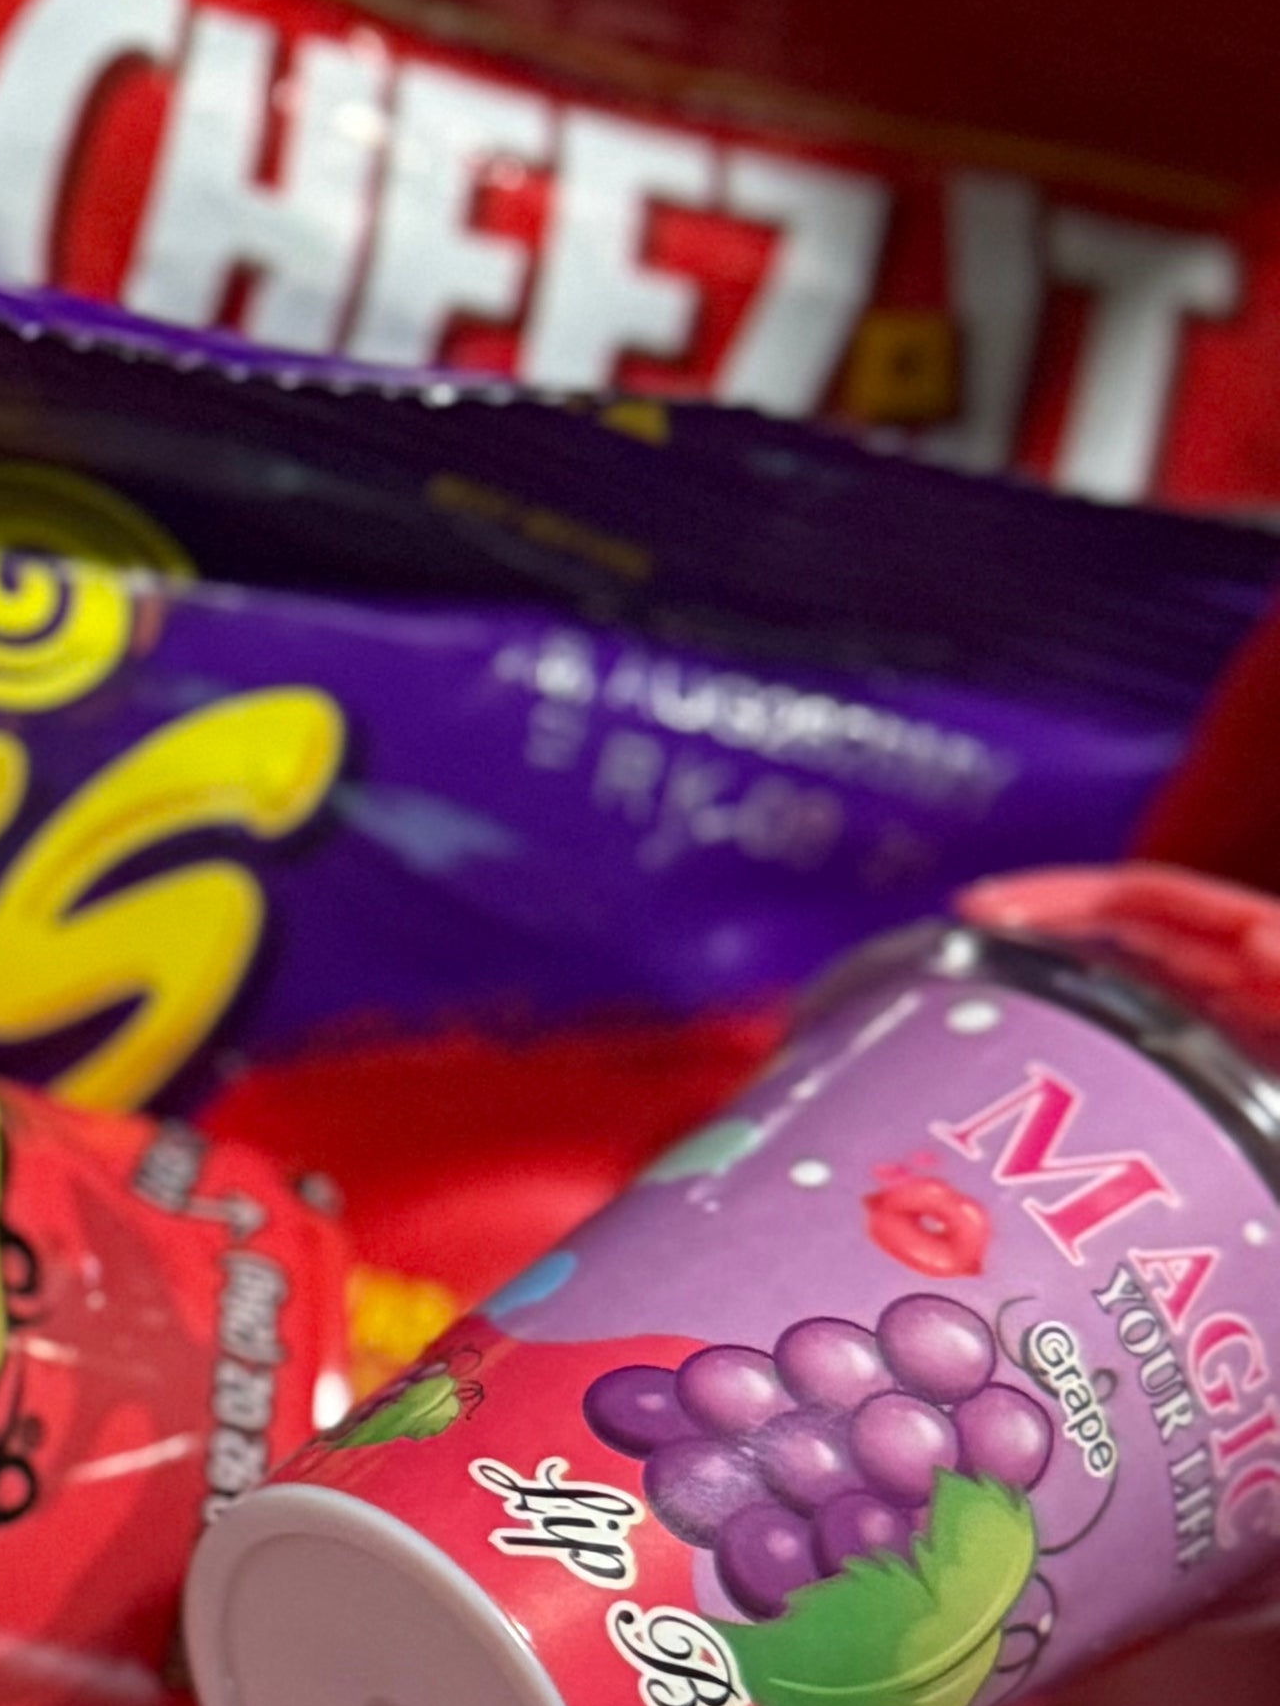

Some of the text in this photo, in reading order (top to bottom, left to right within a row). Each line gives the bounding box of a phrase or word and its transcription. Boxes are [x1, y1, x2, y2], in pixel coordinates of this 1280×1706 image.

[928, 1061, 1280, 1551] MAGIC
[1092, 1263, 1195, 1445] YOUR
[1030, 1320, 1118, 1478] Grape
[469, 1456, 644, 1590] Lip
